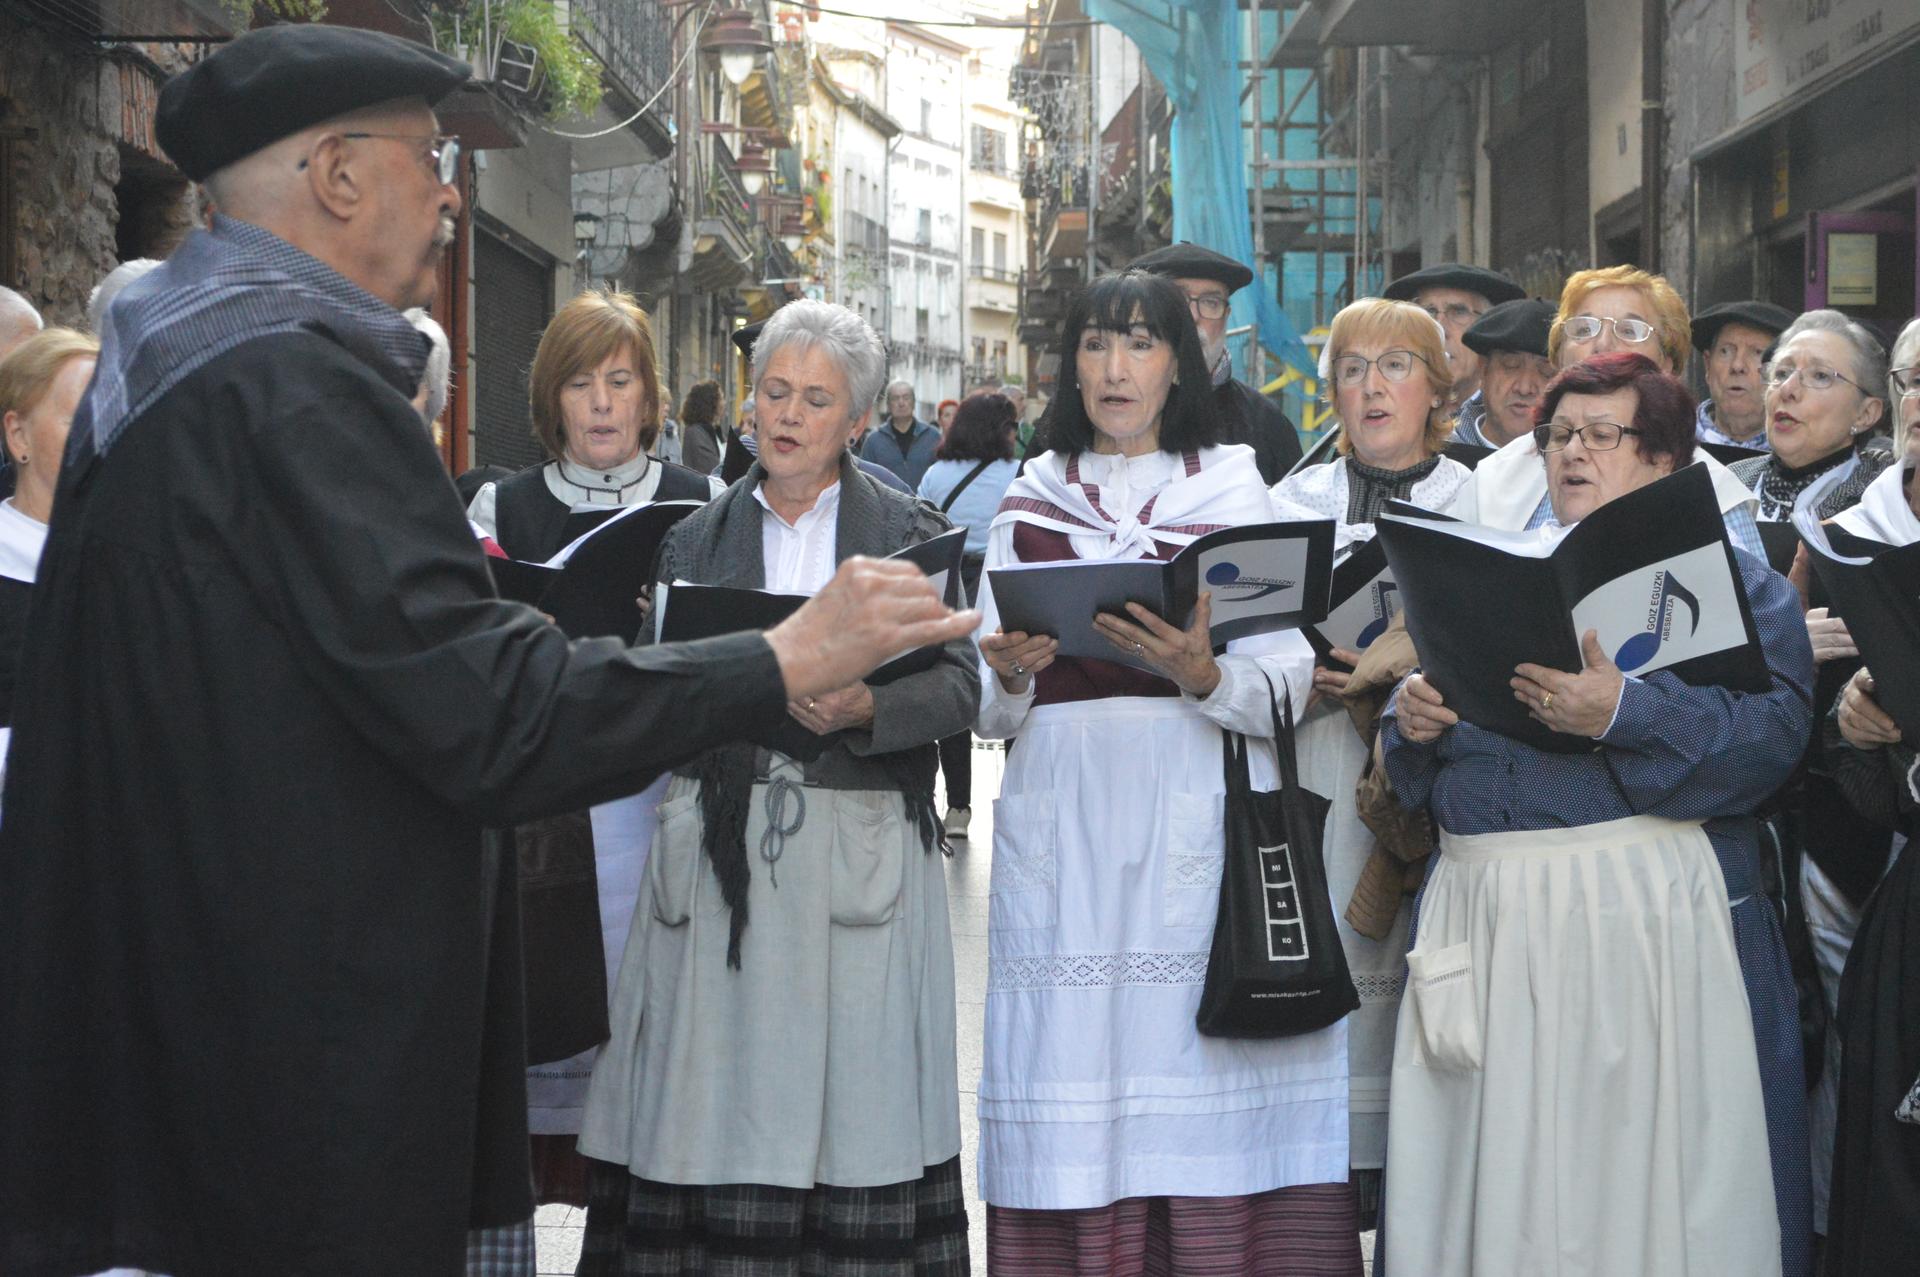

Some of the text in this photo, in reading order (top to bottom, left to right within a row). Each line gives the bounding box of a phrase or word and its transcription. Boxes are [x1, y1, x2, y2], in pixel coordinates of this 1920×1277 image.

[1647, 572, 1663, 630] GOIZ EGUZKI
[1663, 599, 1673, 641] ABESBATZA
